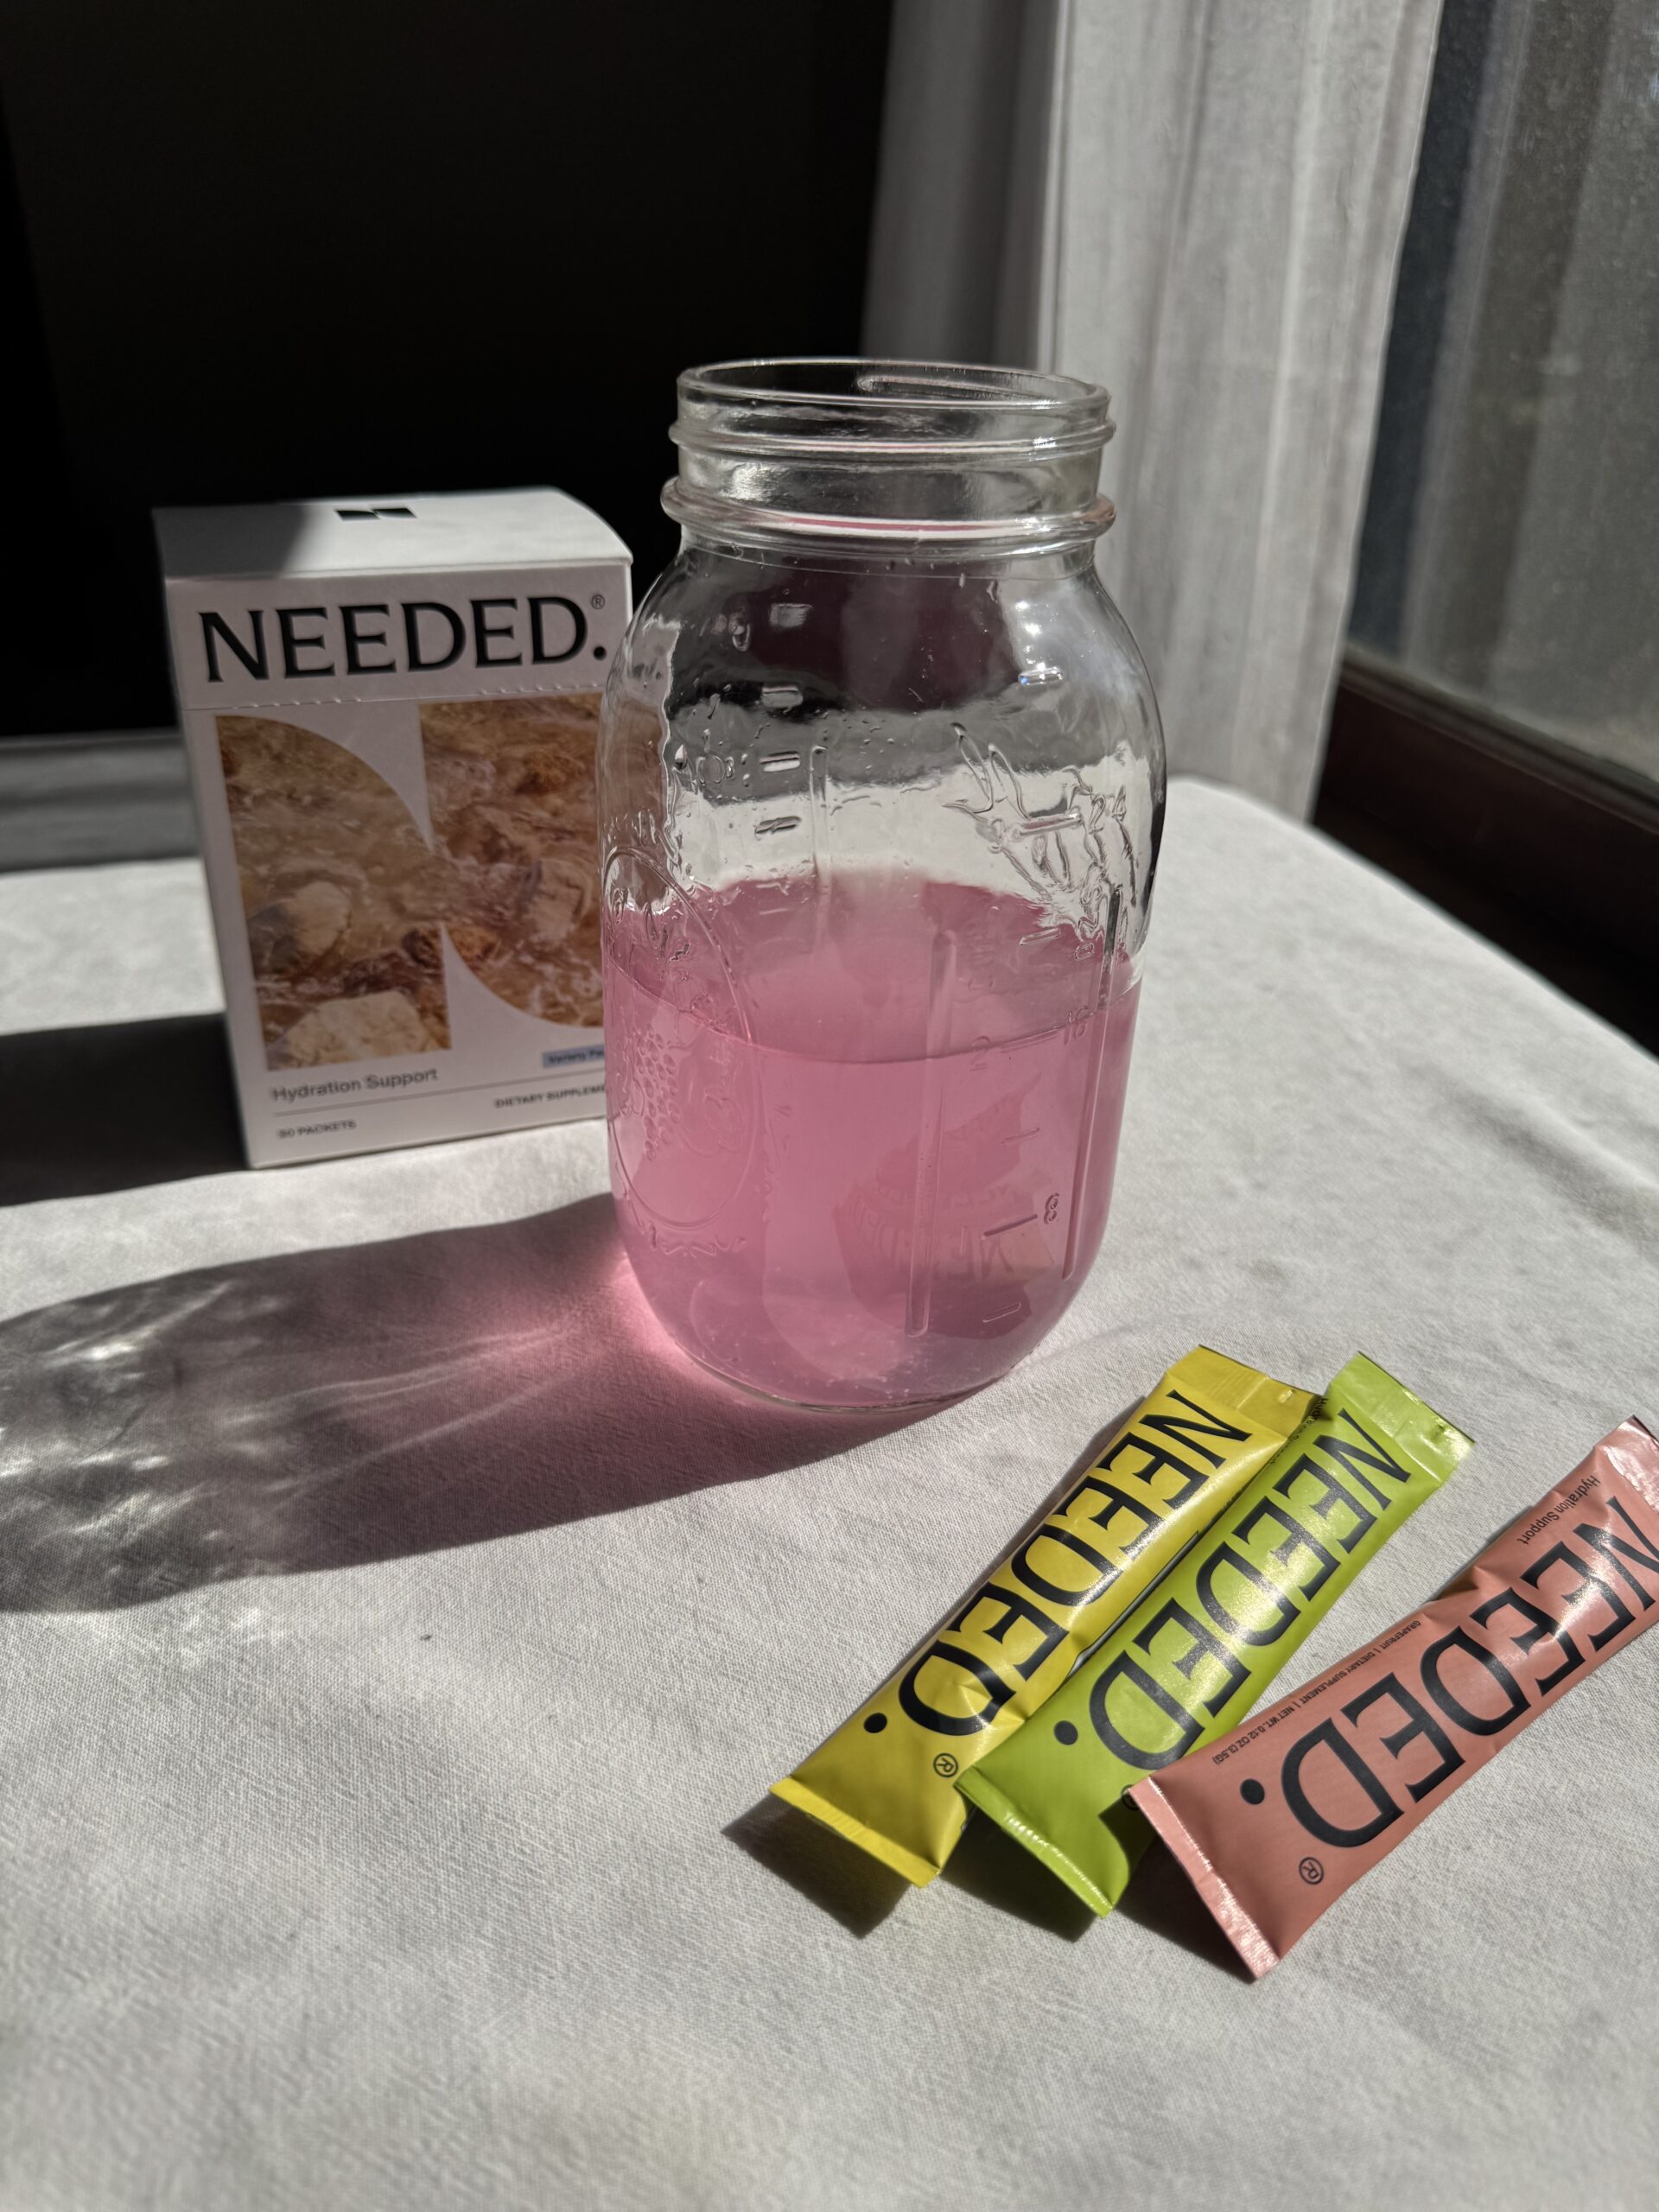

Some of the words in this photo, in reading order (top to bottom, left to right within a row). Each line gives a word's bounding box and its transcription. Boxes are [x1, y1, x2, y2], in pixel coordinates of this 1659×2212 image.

[271, 1079, 362, 1103] Hydration
[365, 1068, 438, 1090] Support
[494, 1092, 543, 1107] DIETARY
[297, 1119, 357, 1136] PACKETS
[1043, 1192, 1060, 1224] 8
[1554, 1475, 1600, 1513] Hydration
[1516, 1511, 1560, 1545] Support
[1382, 1620, 1421, 1649] GRAPEFRUIT
[1348, 1652, 1376, 1674] DIETARY
[1300, 1669, 1348, 1704] SUPPLEMENT
[1278, 1707, 1295, 1721] NET
[1212, 1744, 1239, 1764] (3.5G)
